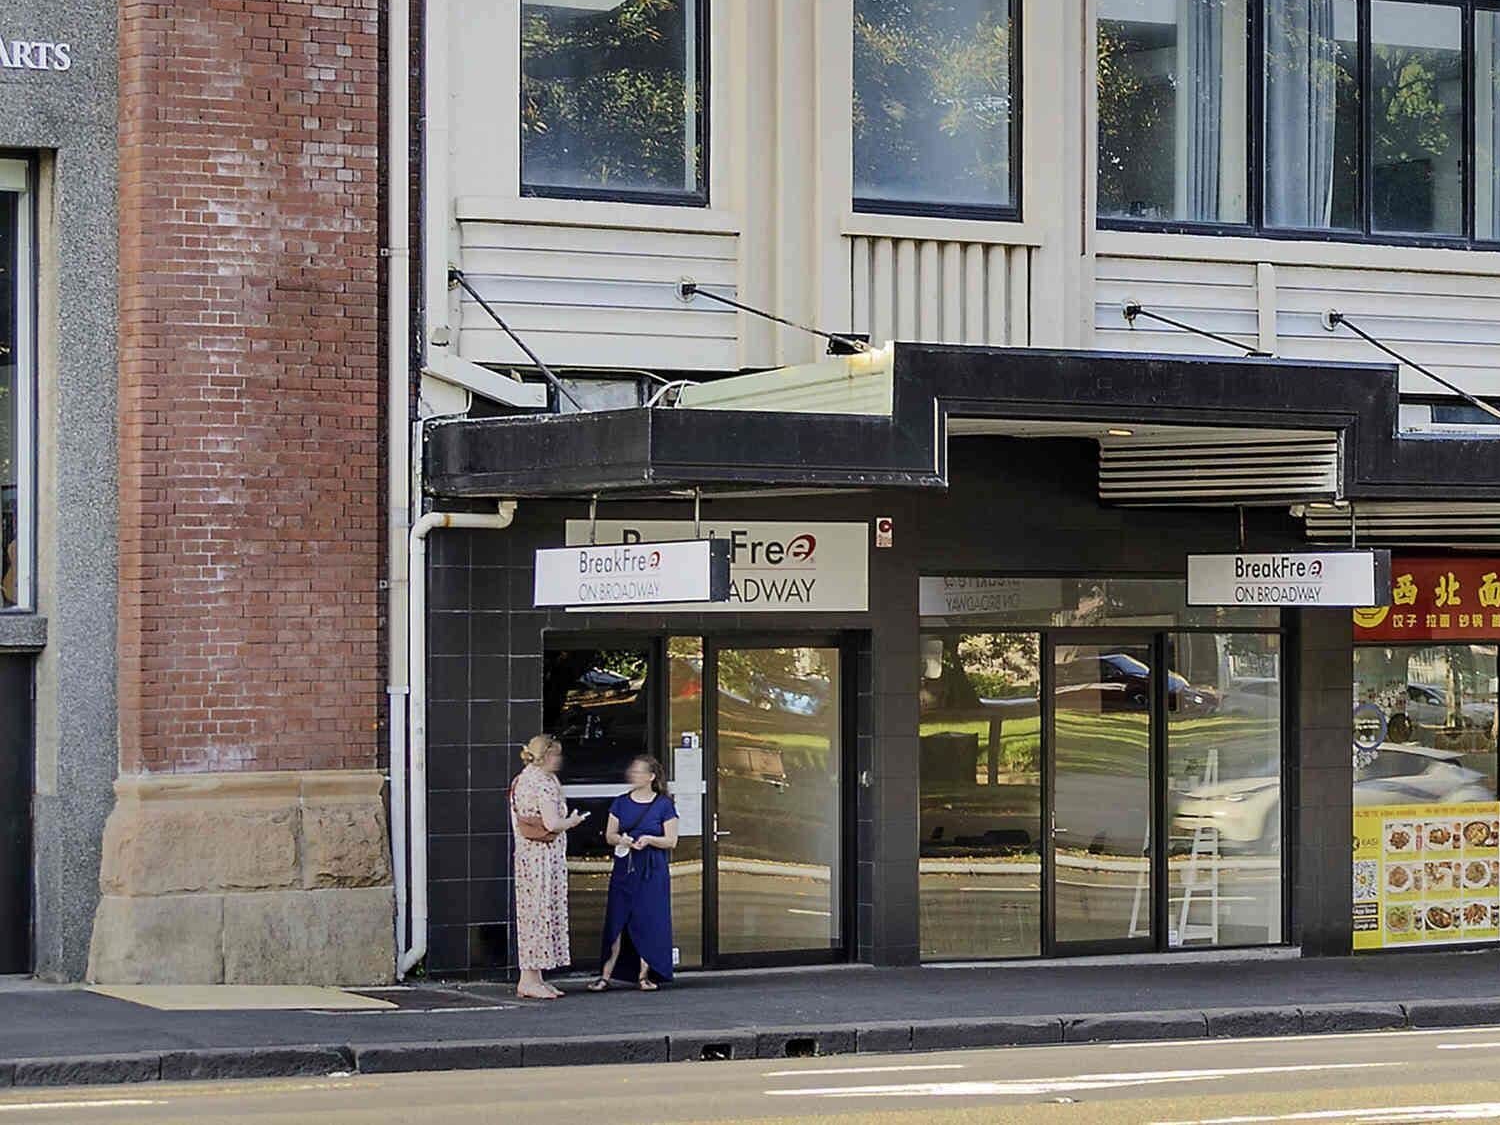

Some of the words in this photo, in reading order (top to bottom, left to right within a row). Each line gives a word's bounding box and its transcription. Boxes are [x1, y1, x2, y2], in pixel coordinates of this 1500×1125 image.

[579, 548, 661, 573] BreakFree
[1235, 556, 1322, 579] BreakFree
[578, 583, 597, 602] ON
[599, 579, 661, 601] BROADWAY
[1235, 586, 1254, 602] ON
[1257, 586, 1322, 602] BROADWAY
